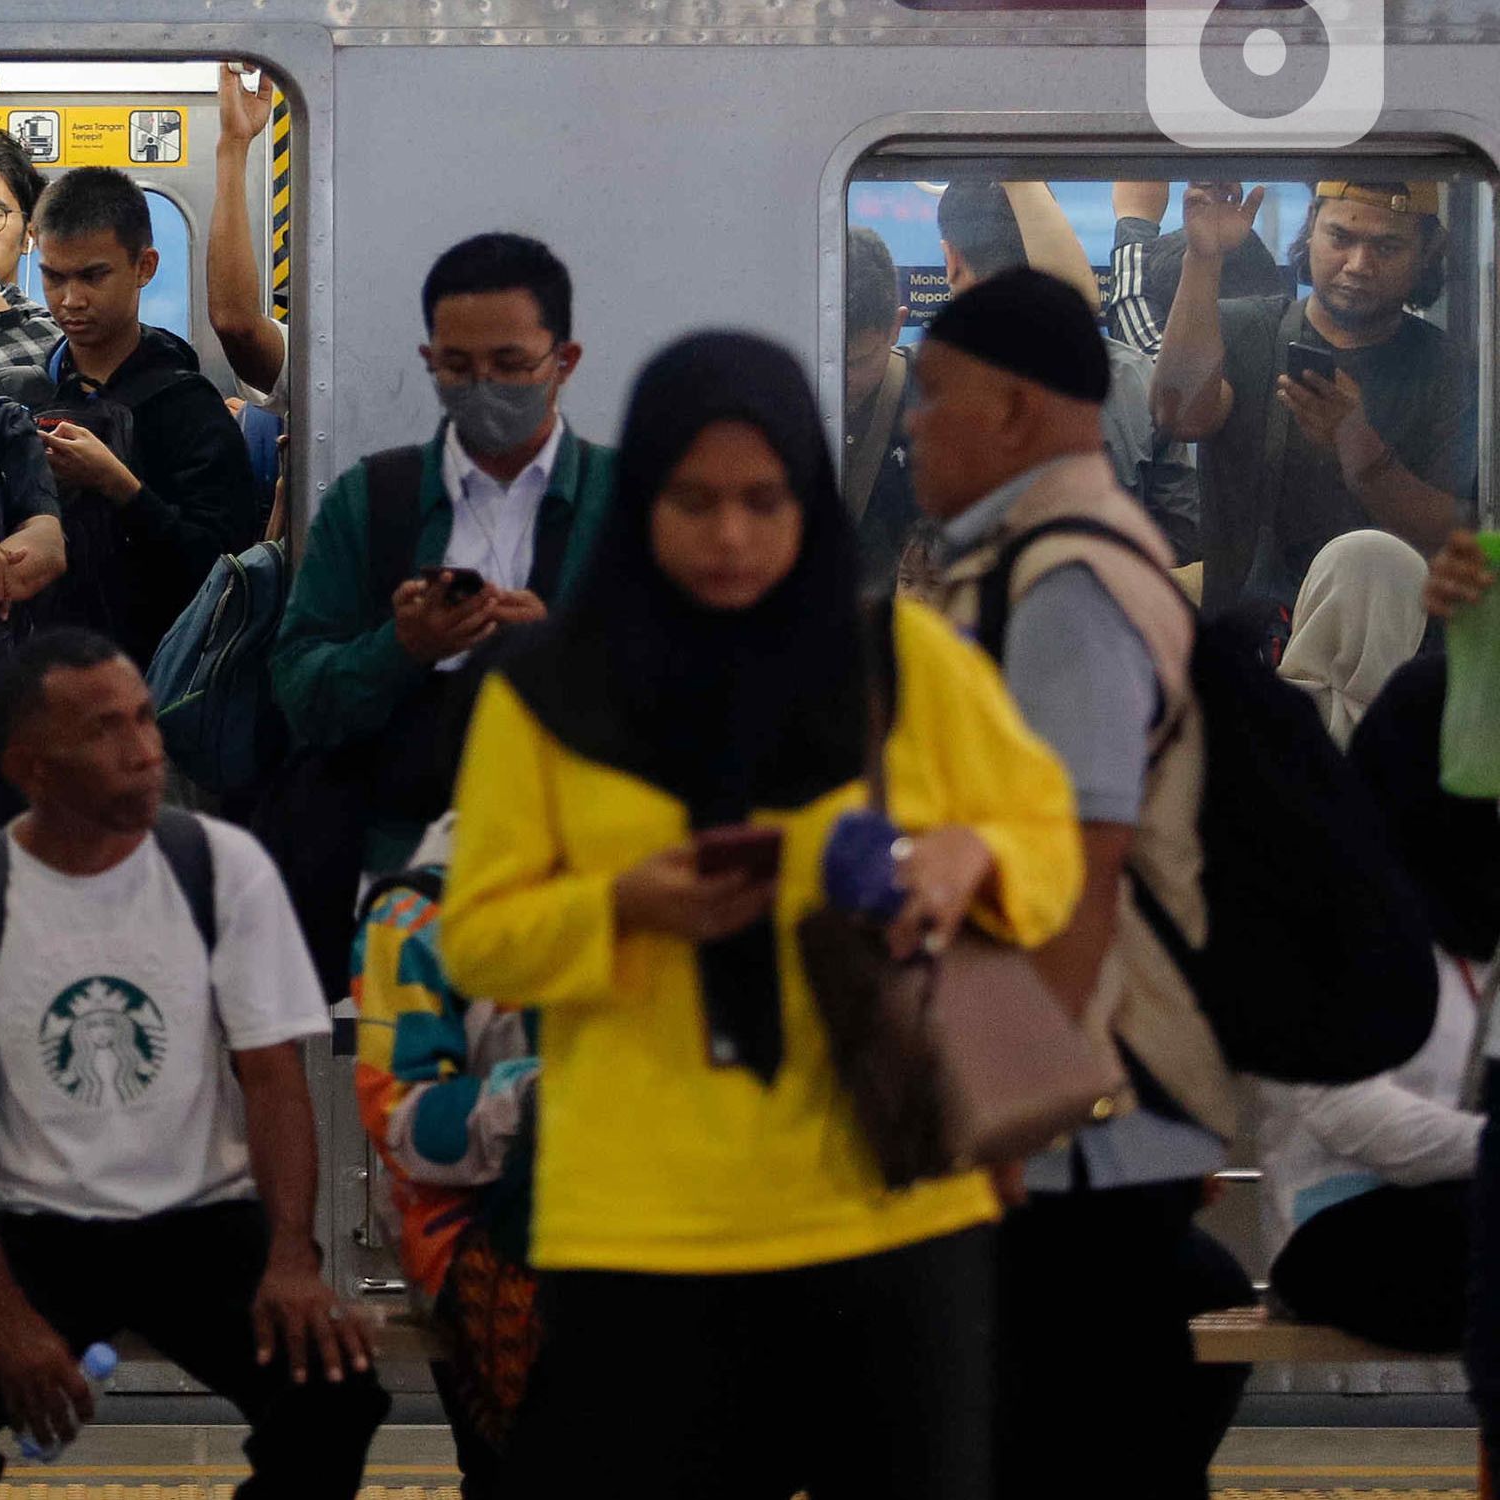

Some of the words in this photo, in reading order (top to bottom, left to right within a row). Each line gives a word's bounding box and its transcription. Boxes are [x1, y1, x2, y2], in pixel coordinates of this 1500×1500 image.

[71, 122, 94, 131] Awas
[94, 122, 125, 132] Tangan
[910, 291, 952, 304] Kepad
